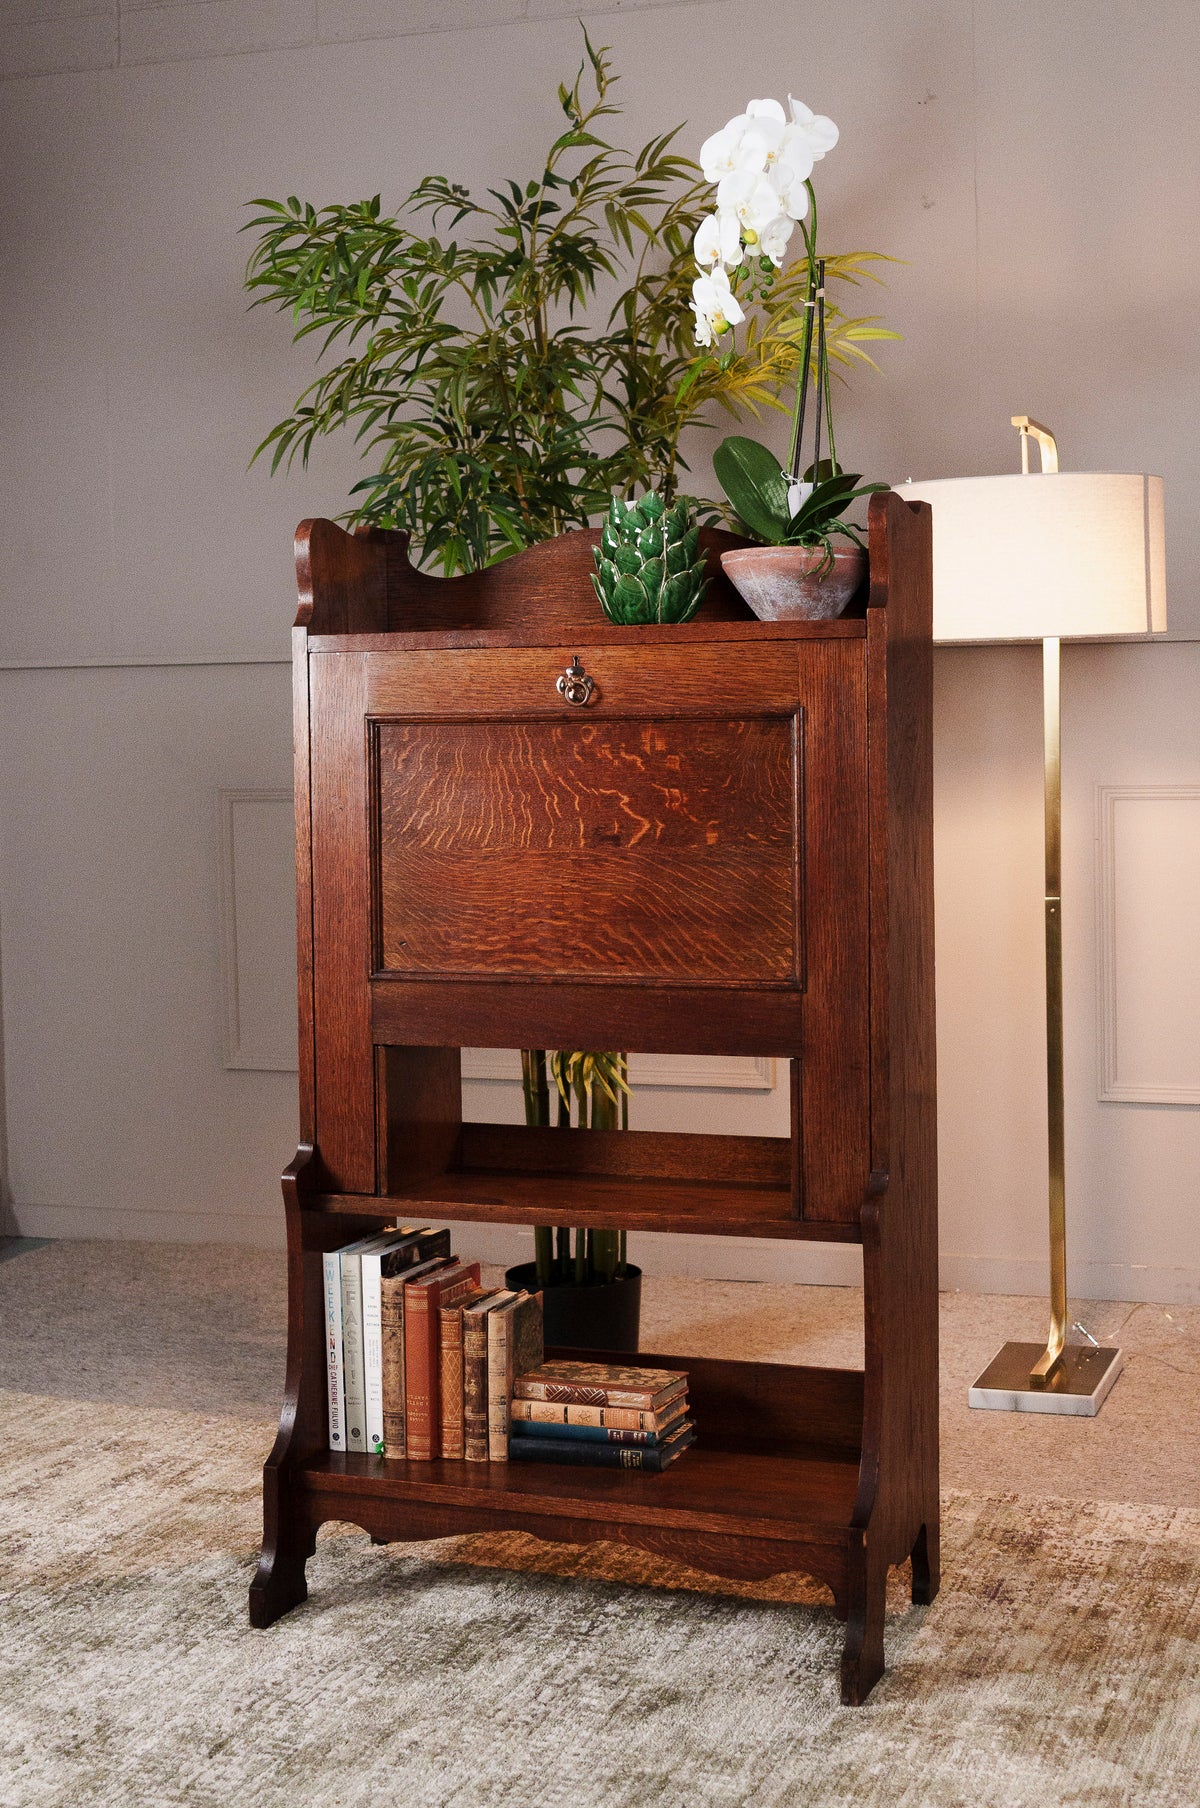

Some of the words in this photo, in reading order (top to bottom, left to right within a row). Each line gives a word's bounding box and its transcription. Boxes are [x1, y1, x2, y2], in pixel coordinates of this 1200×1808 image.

[326, 1269, 337, 1363] WEEKEND
[330, 1371, 338, 1405] CATHERINE
[331, 1406, 339, 1429] FULVIO
